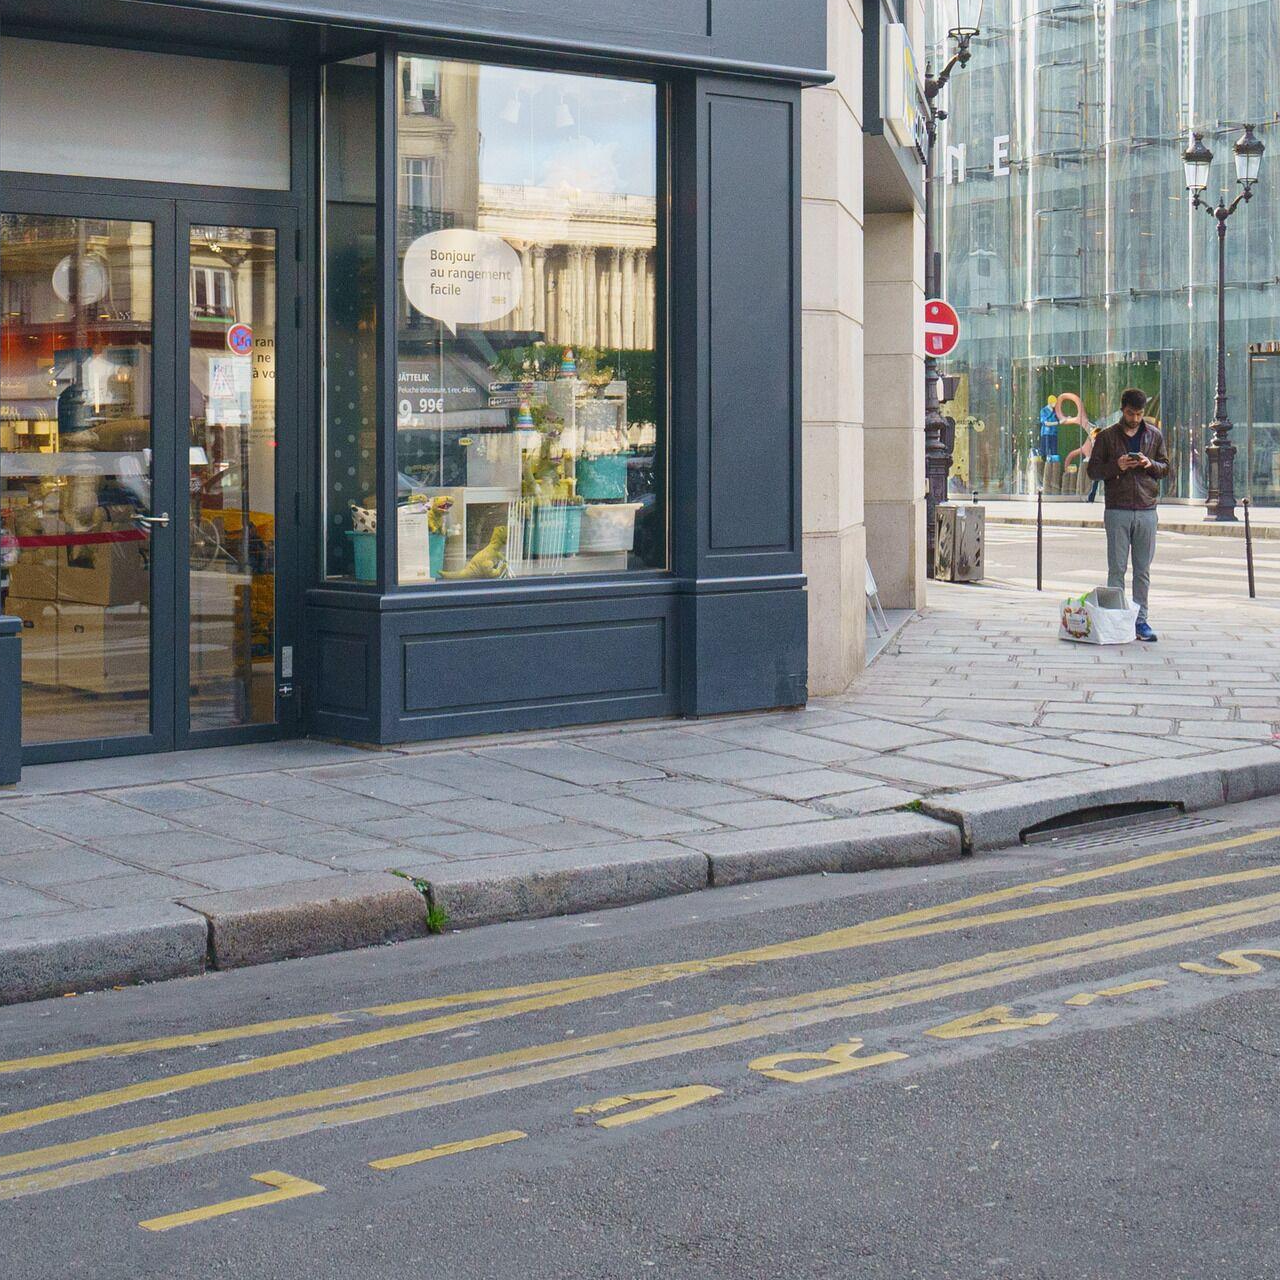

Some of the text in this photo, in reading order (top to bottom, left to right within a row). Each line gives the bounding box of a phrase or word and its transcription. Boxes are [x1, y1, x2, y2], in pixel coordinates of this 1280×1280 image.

[430, 249, 476, 264] Bonjour
[430, 268, 512, 282] au rangement
[430, 282, 461, 295] facile
[257, 354, 272, 363] ne
[398, 371, 430, 382] JÄTTELIK
